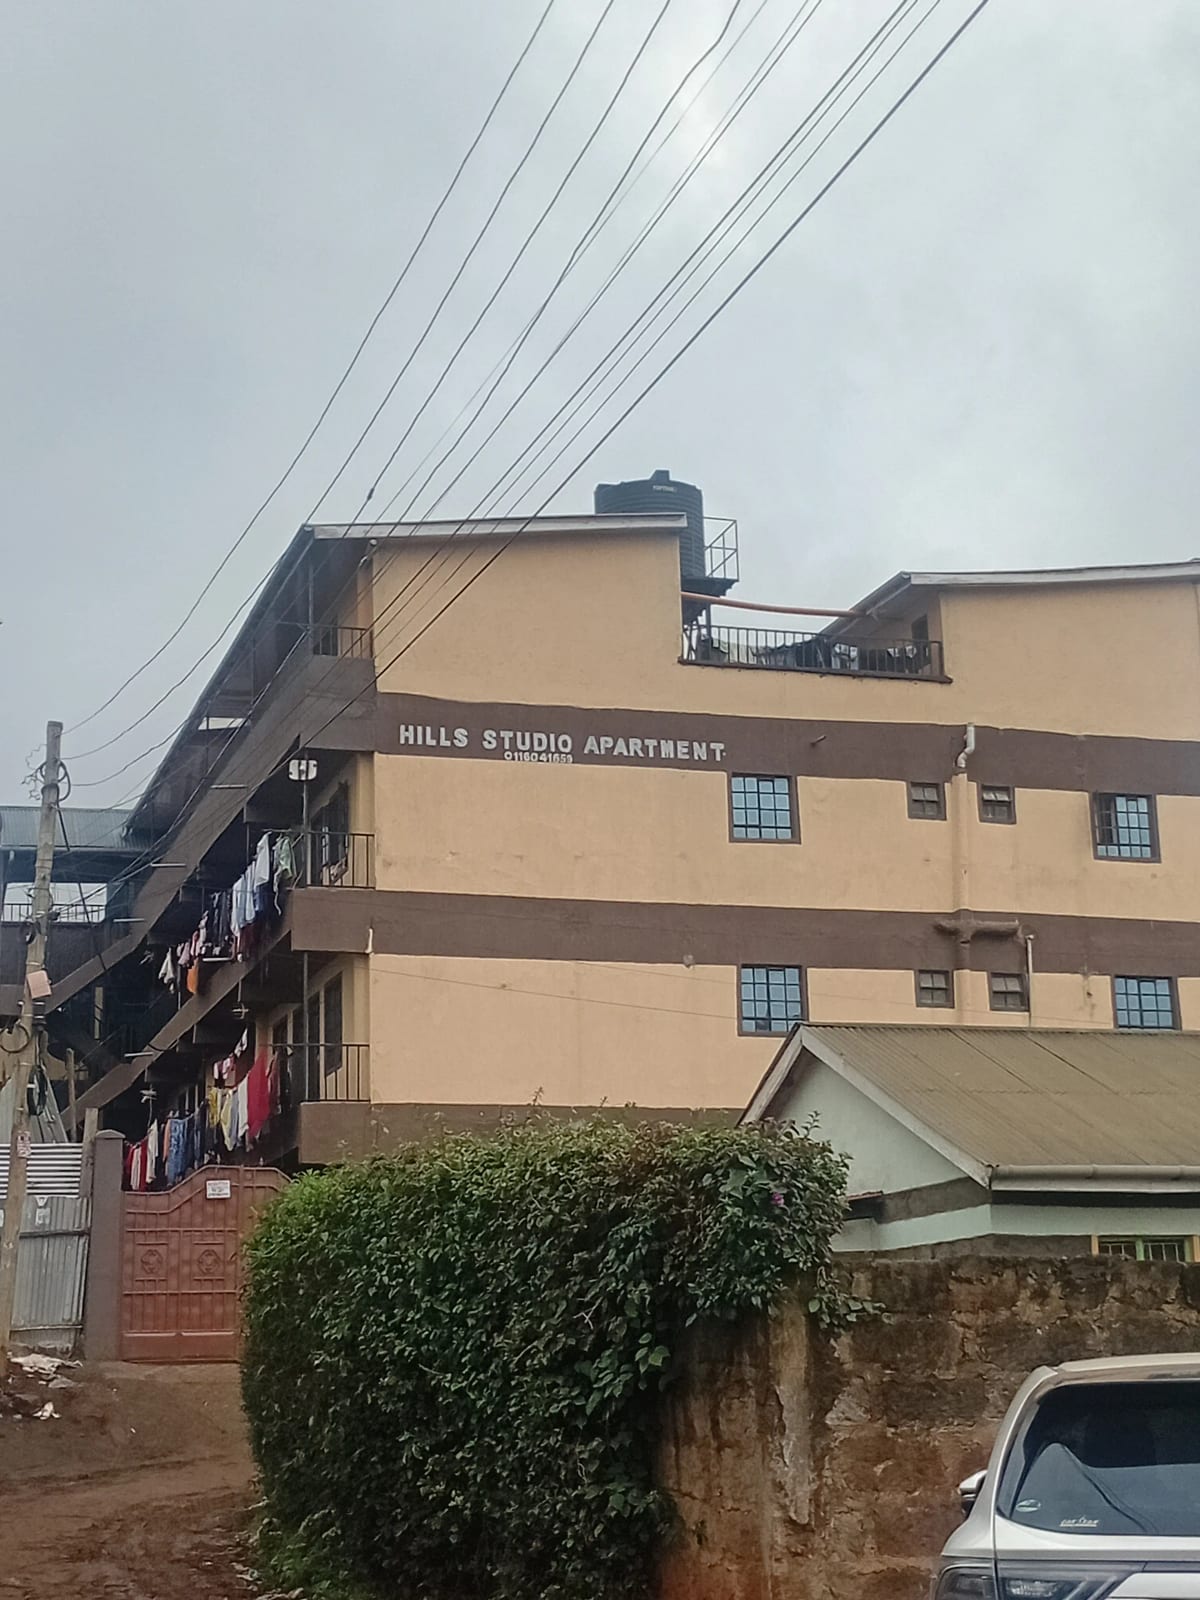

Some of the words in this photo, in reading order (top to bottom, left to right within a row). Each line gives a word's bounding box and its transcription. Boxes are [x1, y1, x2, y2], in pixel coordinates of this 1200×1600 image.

[399, 724, 469, 747] HILLS
[482, 729, 573, 753] STUDIO
[583, 735, 725, 761] APARTMENT
